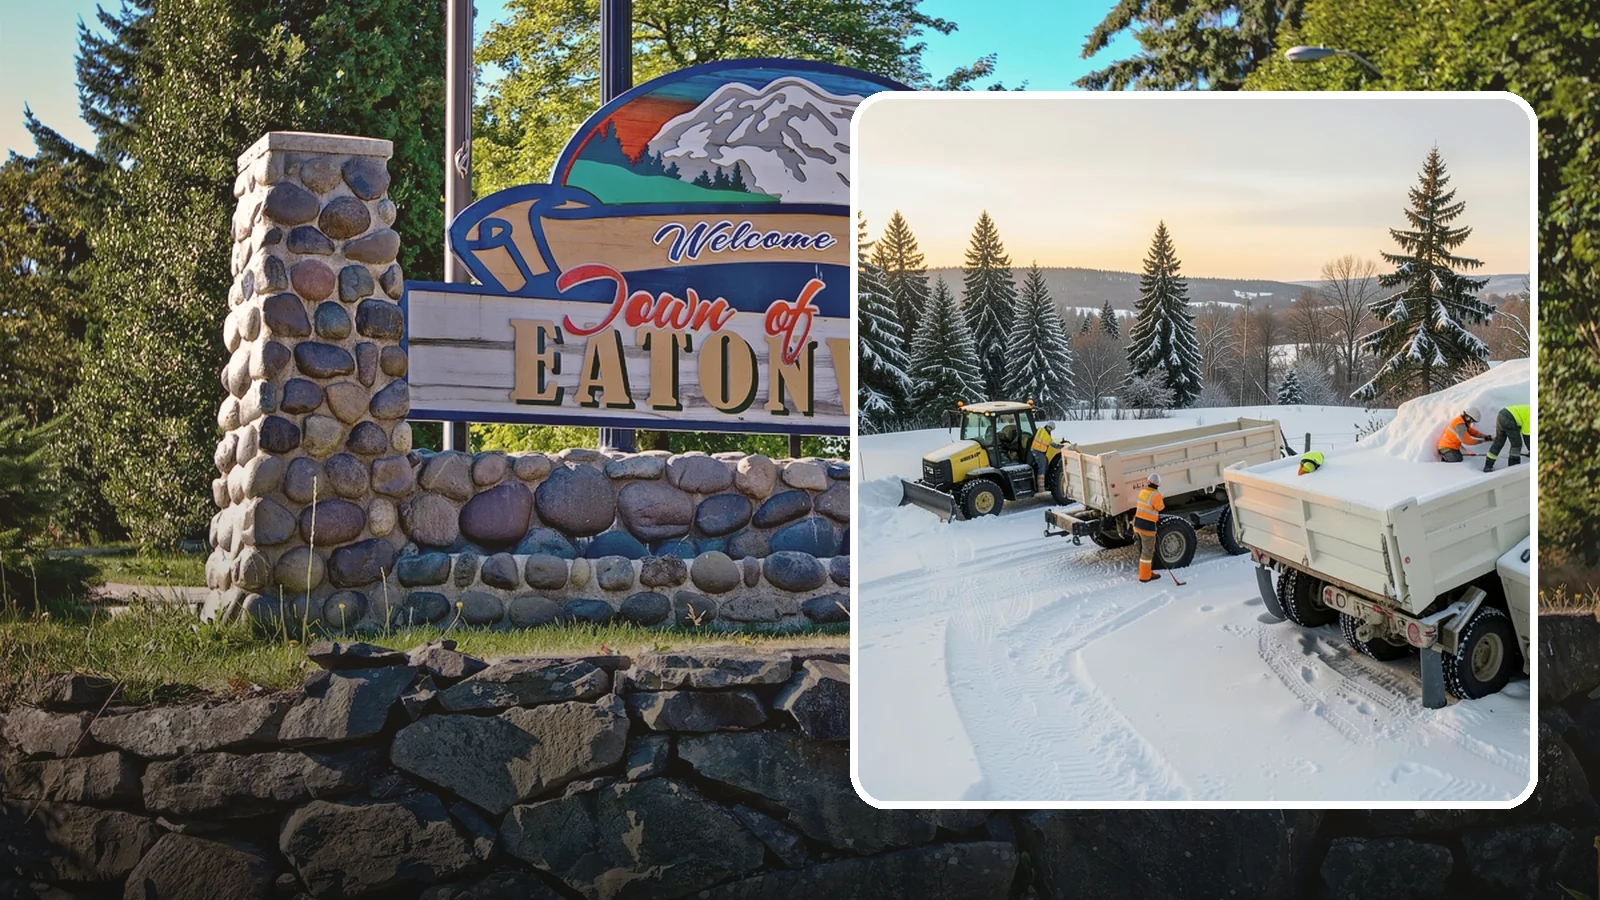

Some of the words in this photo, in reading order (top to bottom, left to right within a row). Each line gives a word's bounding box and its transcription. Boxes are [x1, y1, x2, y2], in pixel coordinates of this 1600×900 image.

[653, 220, 838, 264] Welcome
[556, 262, 737, 337] Town
[764, 277, 826, 366] of
